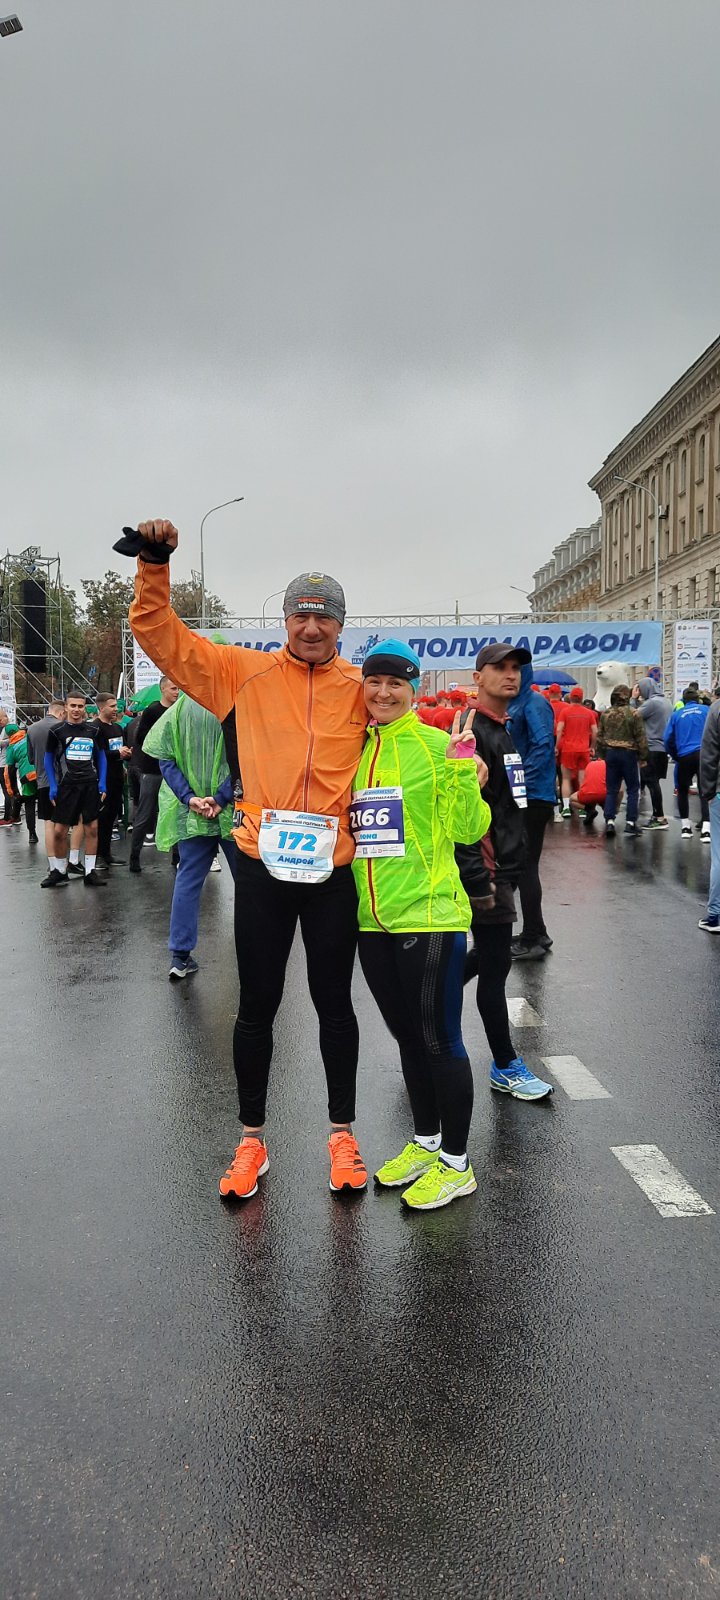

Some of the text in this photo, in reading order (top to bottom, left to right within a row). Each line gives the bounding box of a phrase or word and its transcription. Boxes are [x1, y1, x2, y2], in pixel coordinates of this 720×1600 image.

[350, 807, 391, 829] 2166
[278, 830, 318, 852] 172
[277, 855, 315, 866] Андрей
